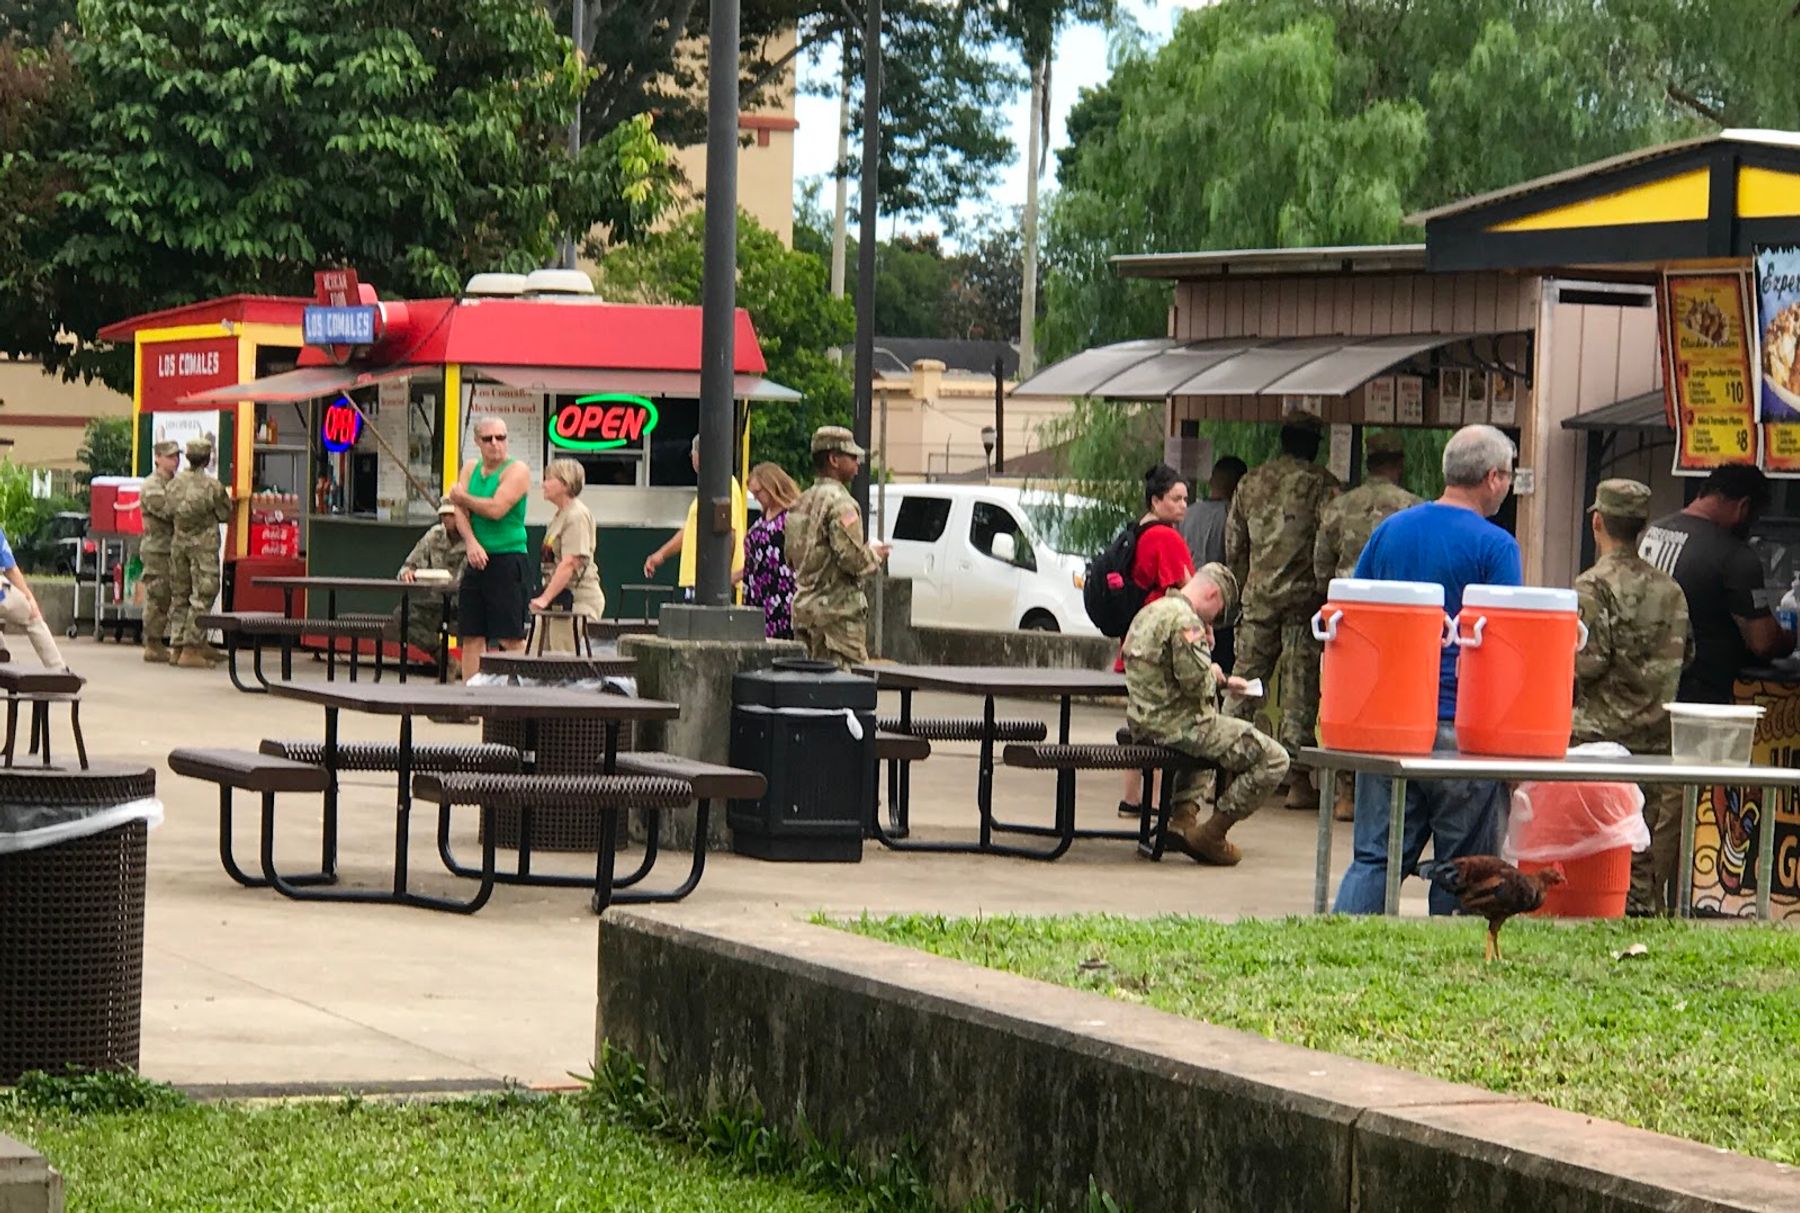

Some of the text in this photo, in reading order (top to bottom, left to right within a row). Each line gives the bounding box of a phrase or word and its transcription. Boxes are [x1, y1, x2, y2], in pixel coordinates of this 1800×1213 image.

[305, 311, 369, 337] LOS COMALES
[158, 351, 220, 377] LOS COMALES
[1725, 381, 1744, 404] $10
[326, 405, 358, 444] OPEN
[557, 405, 646, 440] OPEN
